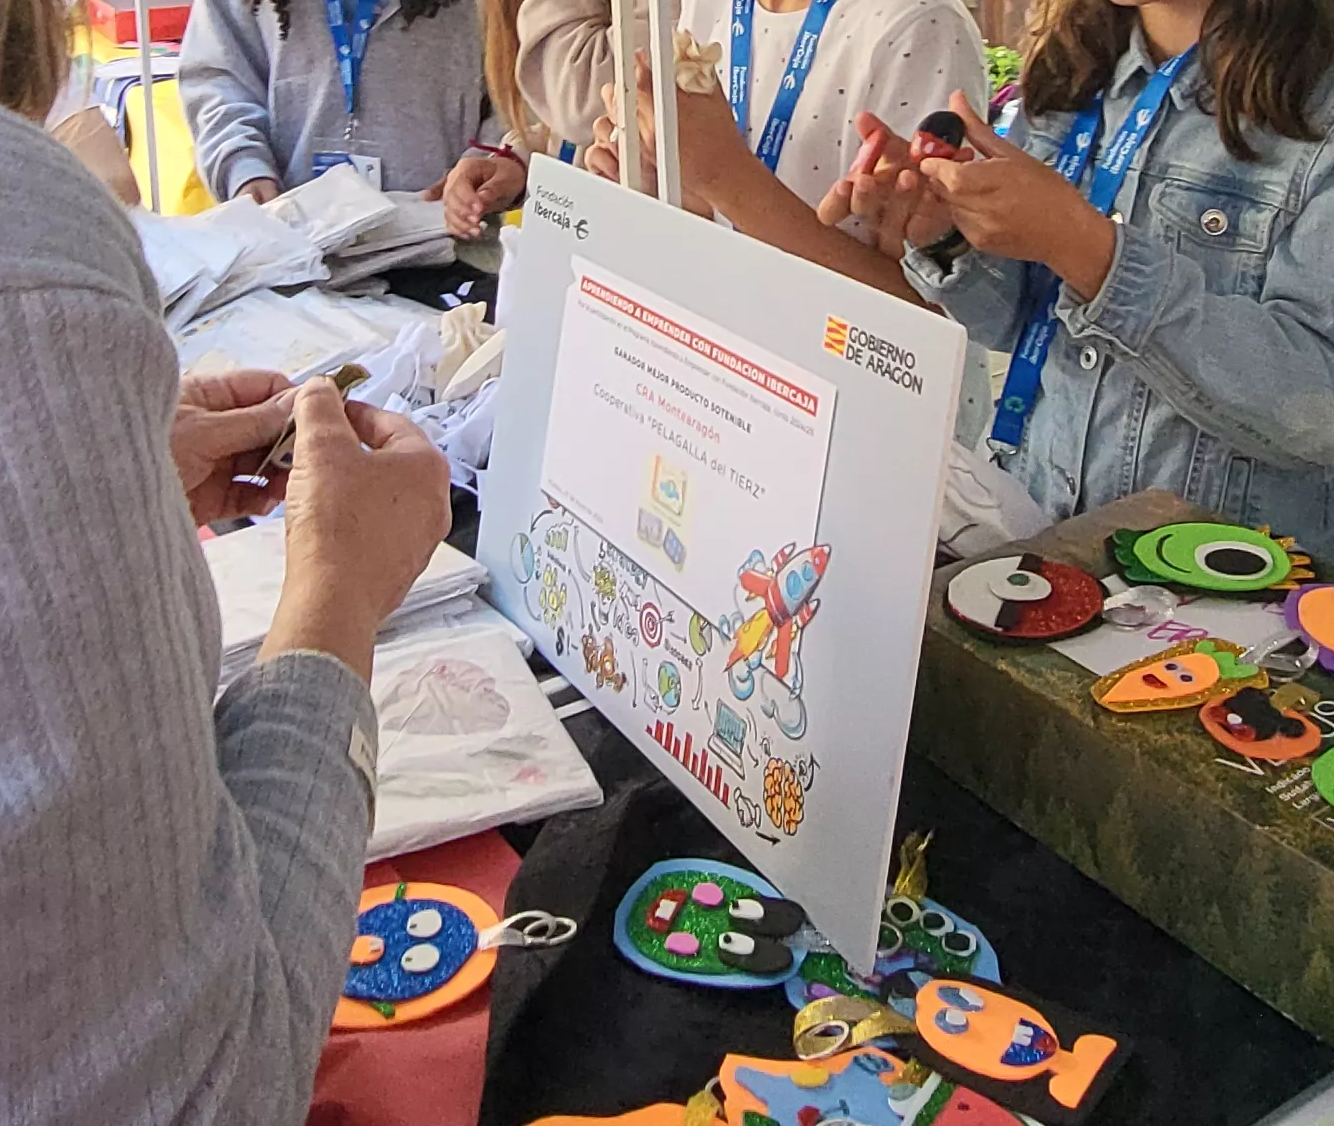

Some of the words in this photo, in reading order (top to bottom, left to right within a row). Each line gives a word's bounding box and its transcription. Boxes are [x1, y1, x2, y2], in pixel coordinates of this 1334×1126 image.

[581, 279, 634, 315] APRENDIENDO
[634, 307, 642, 319] A
[642, 309, 691, 345] EMPRENDER
[692, 337, 712, 355] CON
[766, 376, 816, 413] IBERCAJA
[846, 344, 864, 365] DE
[849, 326, 916, 370] GOBIERNO
[614, 346, 646, 371] GANADOR
[647, 364, 670, 384] MEJOR
[671, 379, 709, 409] PRODUCTO
[593, 383, 645, 425] Cooperativa
[710, 458, 727, 477] del
[636, 382, 655, 404] CRA
[658, 394, 721, 444] Montearagón
